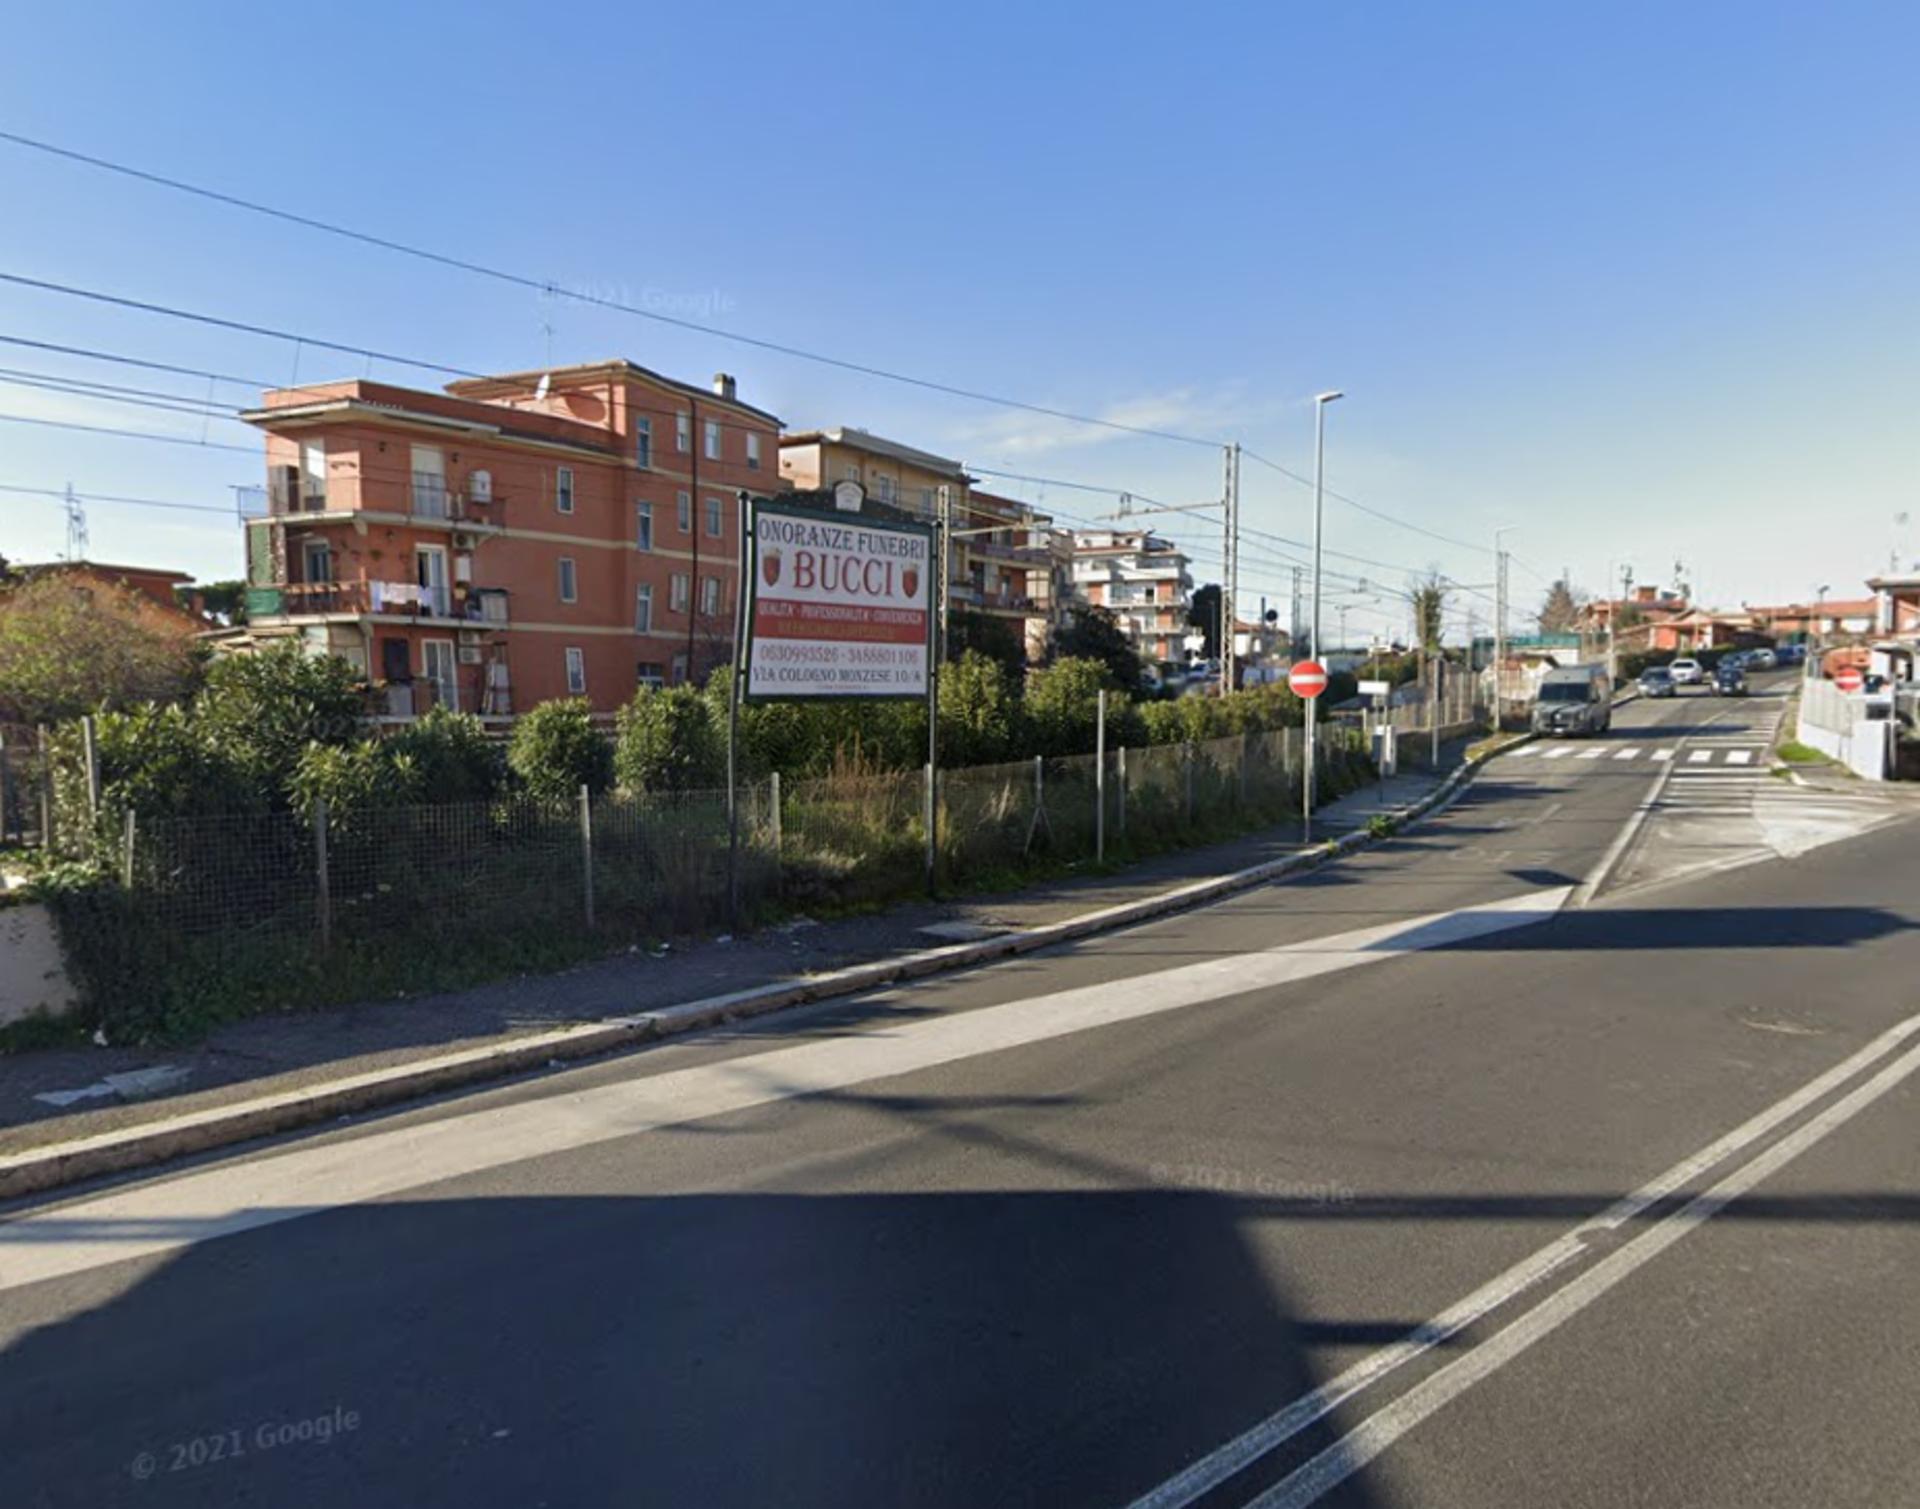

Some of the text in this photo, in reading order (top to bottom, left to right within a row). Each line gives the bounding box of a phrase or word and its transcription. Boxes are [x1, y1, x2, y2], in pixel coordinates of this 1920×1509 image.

[758, 518, 926, 559] ONORANZE FUNEBRI
[793, 550, 894, 597] BUCCI
[753, 665, 776, 682] VIA
[778, 667, 836, 682] COLOGNO
[838, 668, 892, 683] MONZESE
